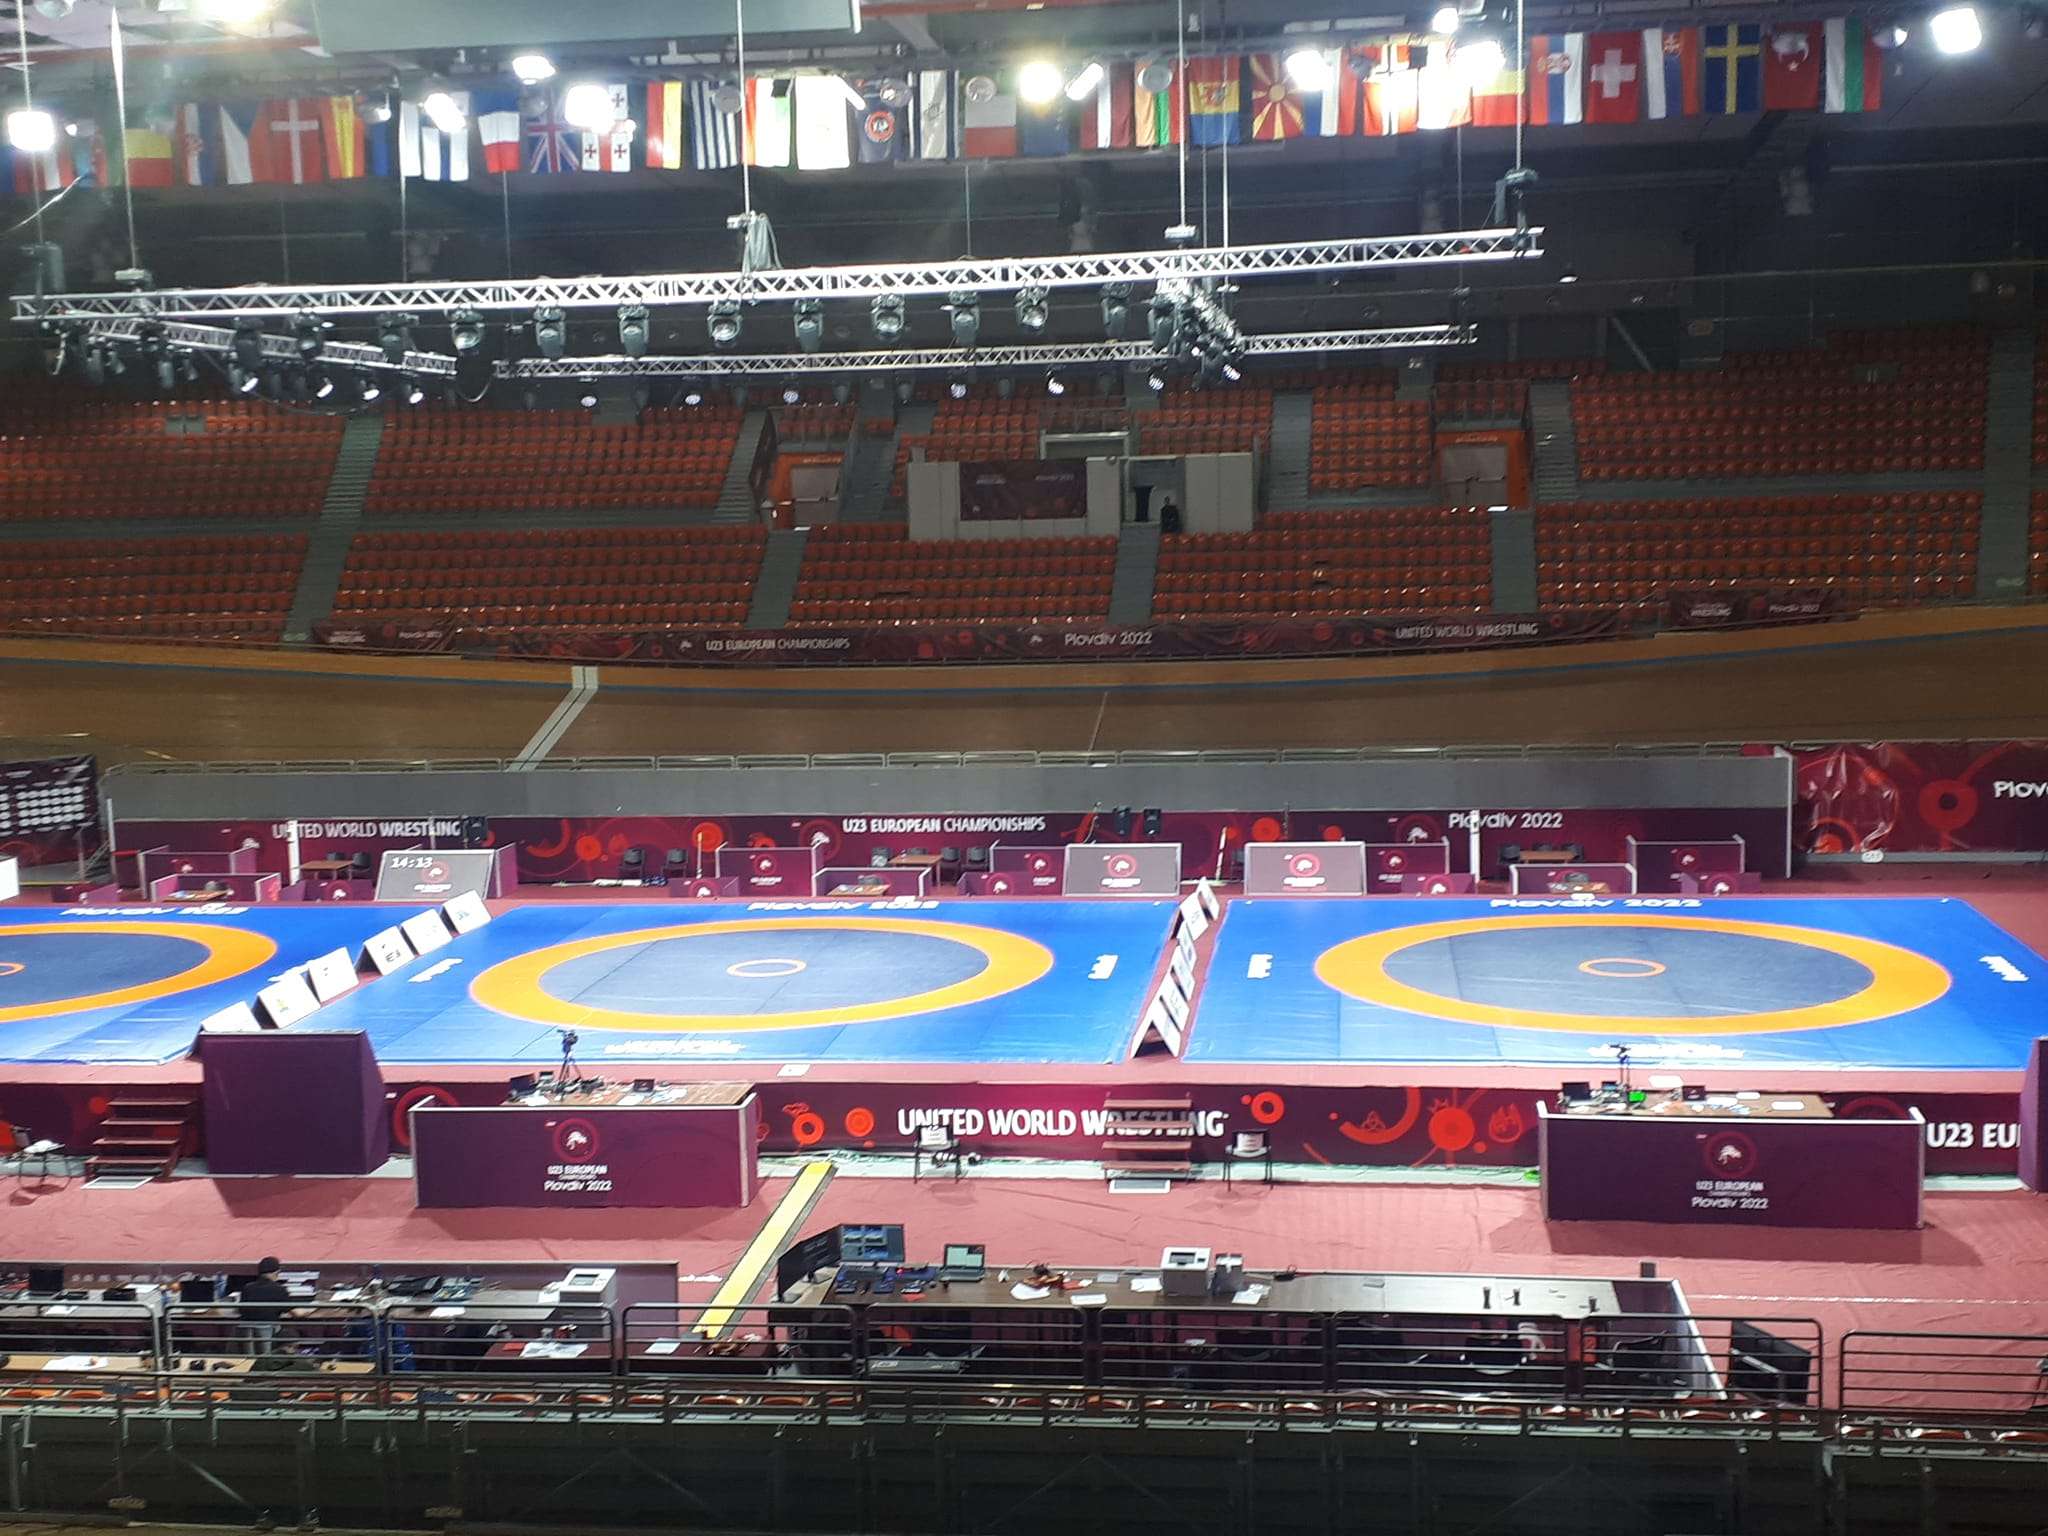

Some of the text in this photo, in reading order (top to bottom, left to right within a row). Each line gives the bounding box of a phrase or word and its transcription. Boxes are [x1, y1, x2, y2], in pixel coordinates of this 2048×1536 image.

[1475, 622, 1539, 637] WRESTLING
[705, 638, 850, 651] U23 EUROPEAN CHAMPIONSHIPS
[1064, 630, 1153, 646] Plovdiv 2022
[1992, 780, 2048, 799] Plov
[842, 816, 1046, 833] U23 EUROPEAN CHAMPIONSHIPS
[1520, 812, 1564, 829] 2022
[324, 822, 378, 839] WORLD
[378, 820, 462, 837] WRESTLING
[988, 1108, 1077, 1137] WORLD
[1926, 1122, 1974, 1148] U23
[544, 1179, 613, 1192] Plovdiv 2022
[1714, 1180, 1764, 1191] EUROPEAN
[1691, 1196, 1769, 1209] Plovdiv 2022
